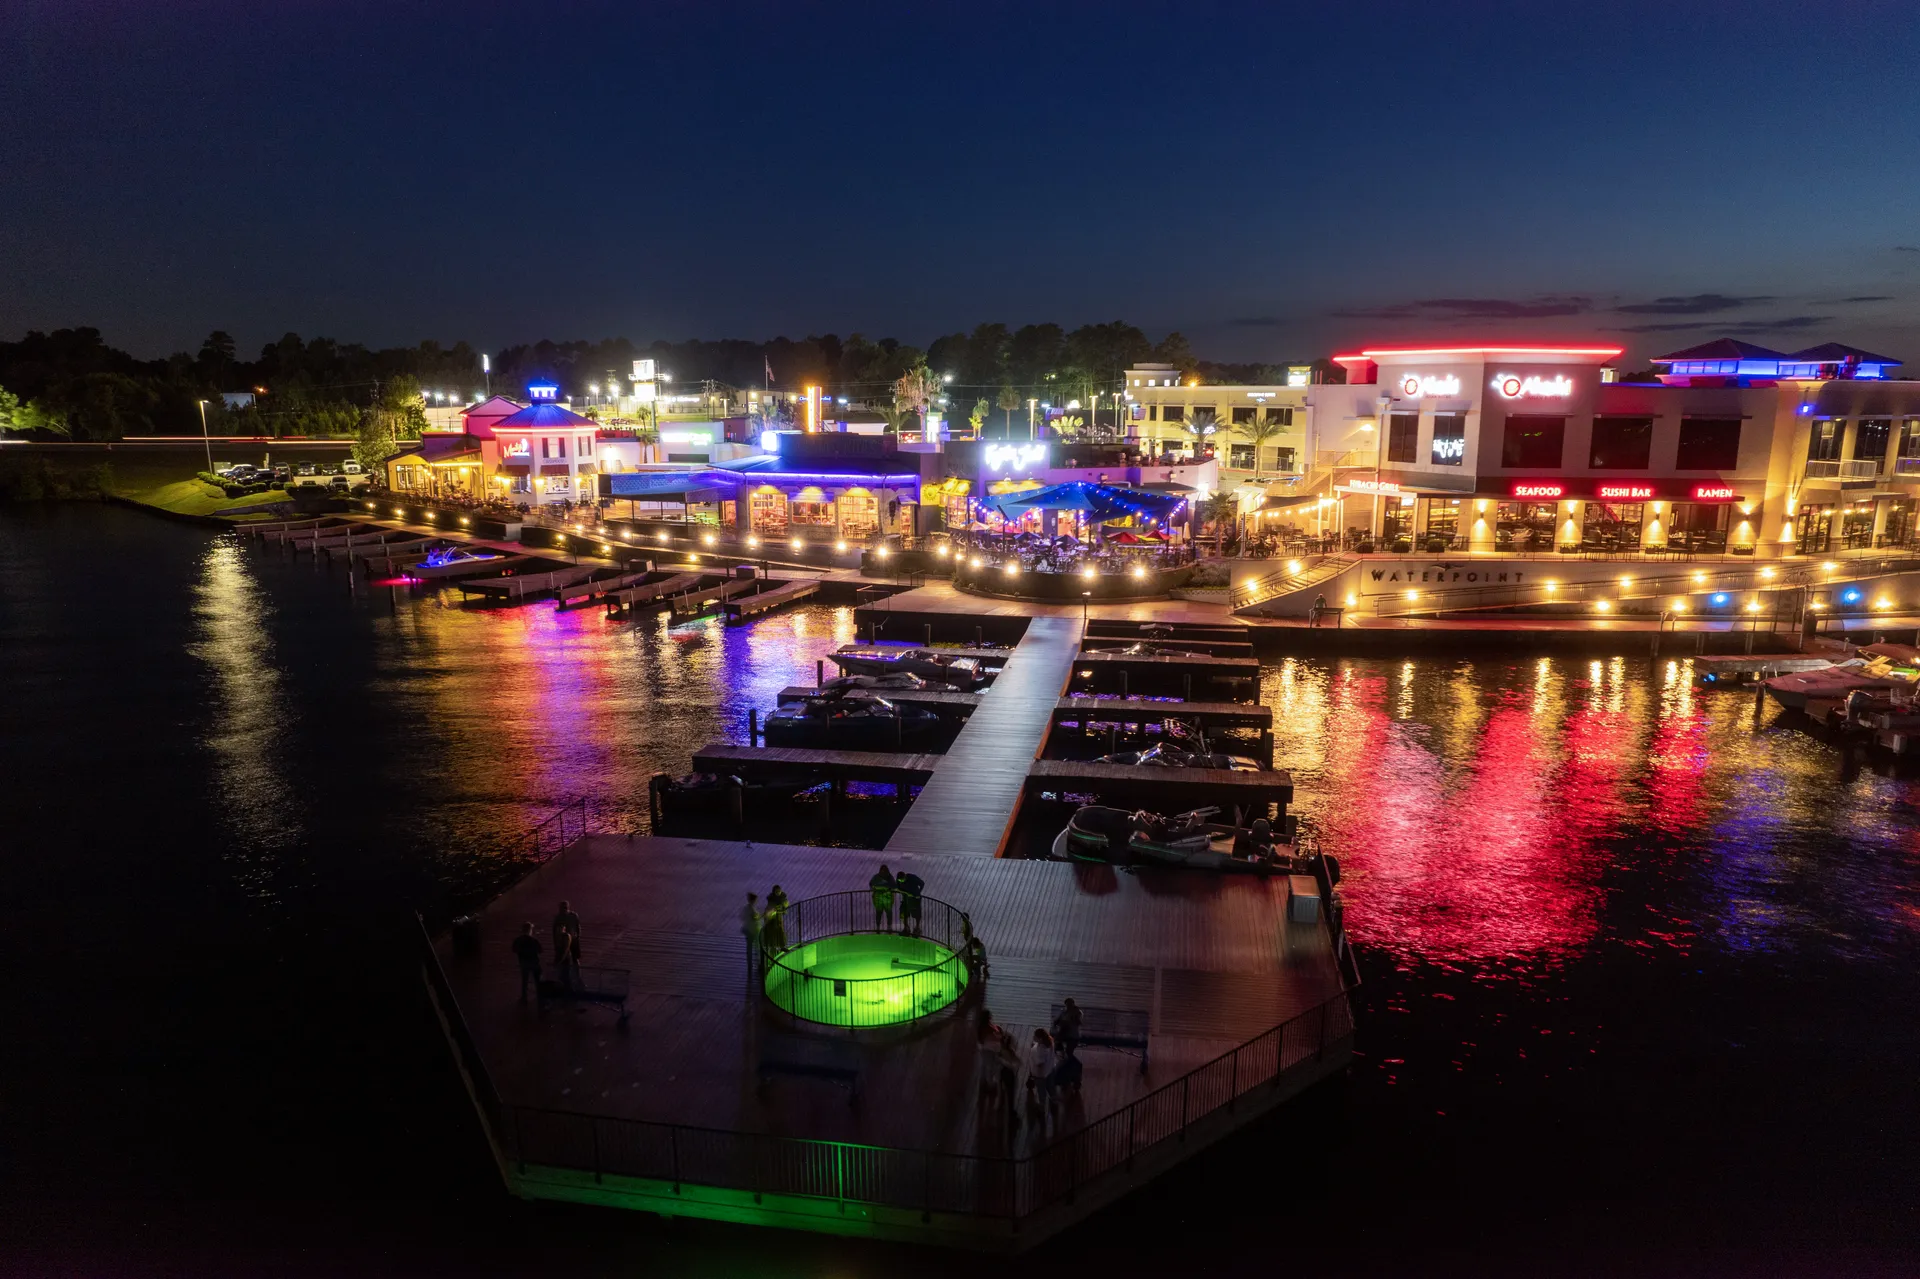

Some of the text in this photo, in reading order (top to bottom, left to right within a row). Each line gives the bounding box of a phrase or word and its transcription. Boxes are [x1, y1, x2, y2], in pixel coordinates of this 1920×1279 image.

[1515, 486, 1561, 496] SEAFOOD
[1601, 487, 1651, 497] SUSHI BAR
[1697, 488, 1733, 498] RAMEN
[1371, 569, 1523, 582] WATERPOINT
